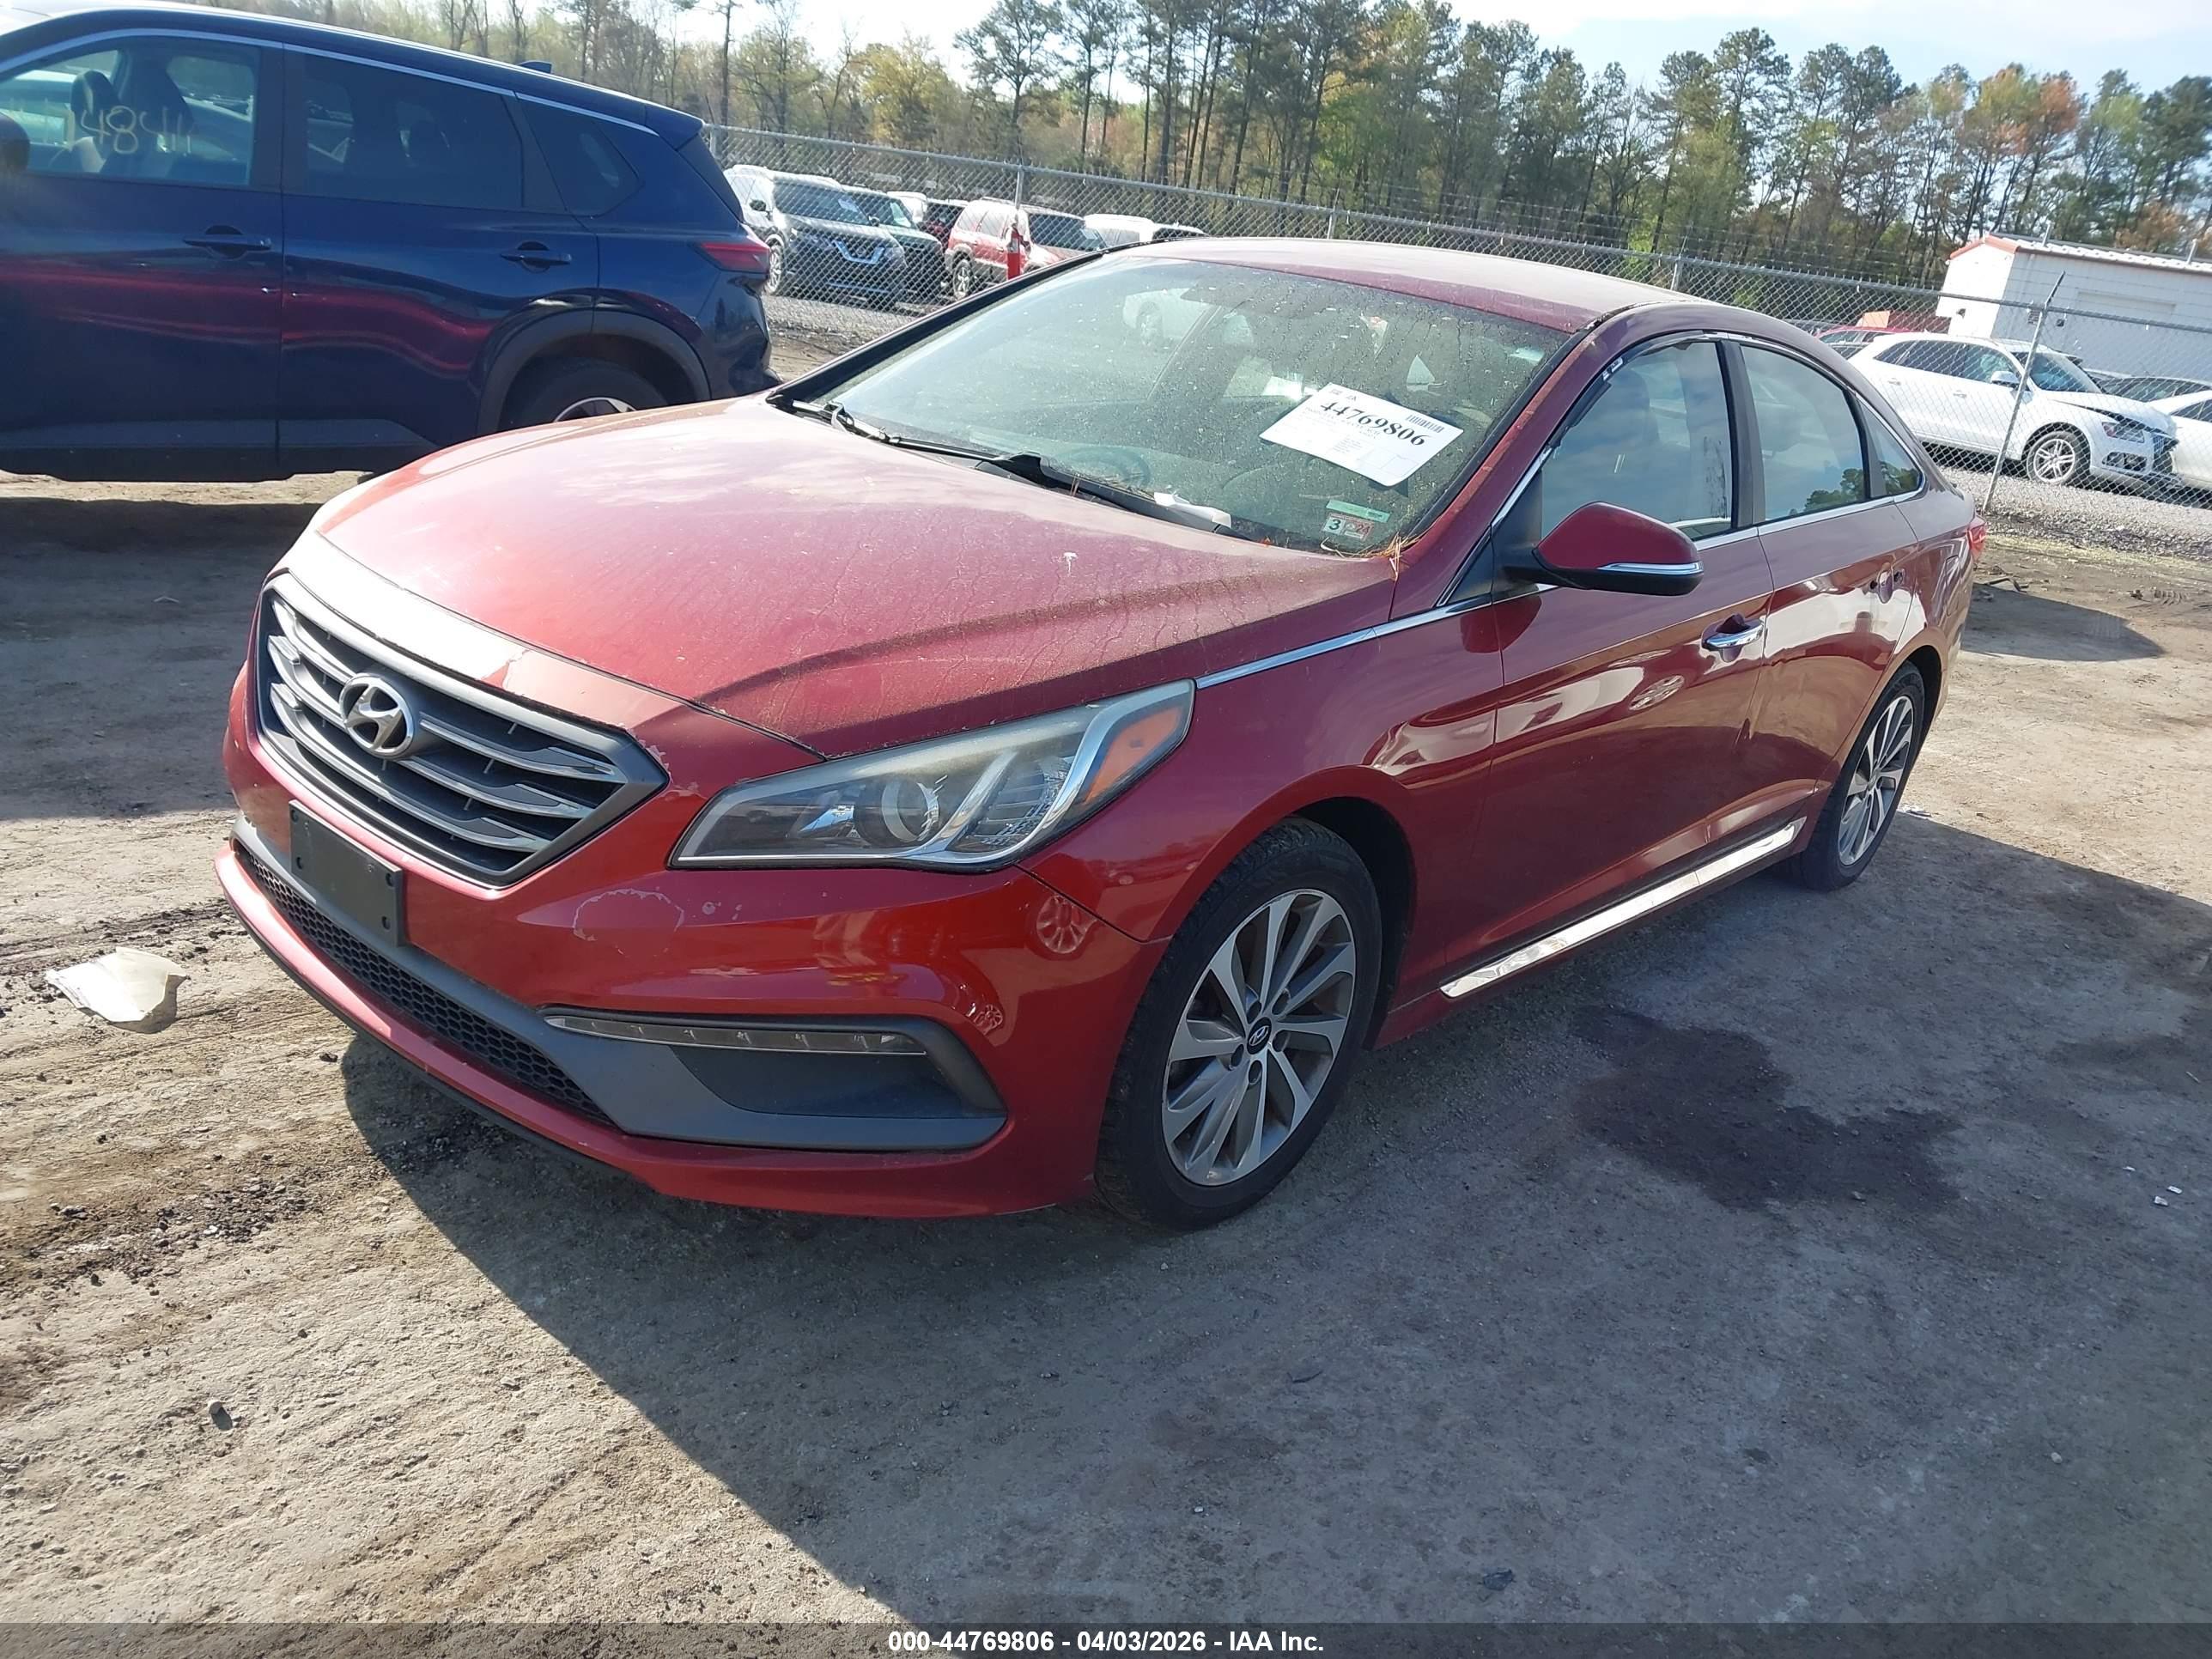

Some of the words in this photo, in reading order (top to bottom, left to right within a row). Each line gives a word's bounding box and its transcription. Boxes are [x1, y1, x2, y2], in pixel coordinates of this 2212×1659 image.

[1321, 402, 1431, 446] 44769806
[1328, 519, 1341, 531] 3
[1356, 524, 1370, 535] 24
